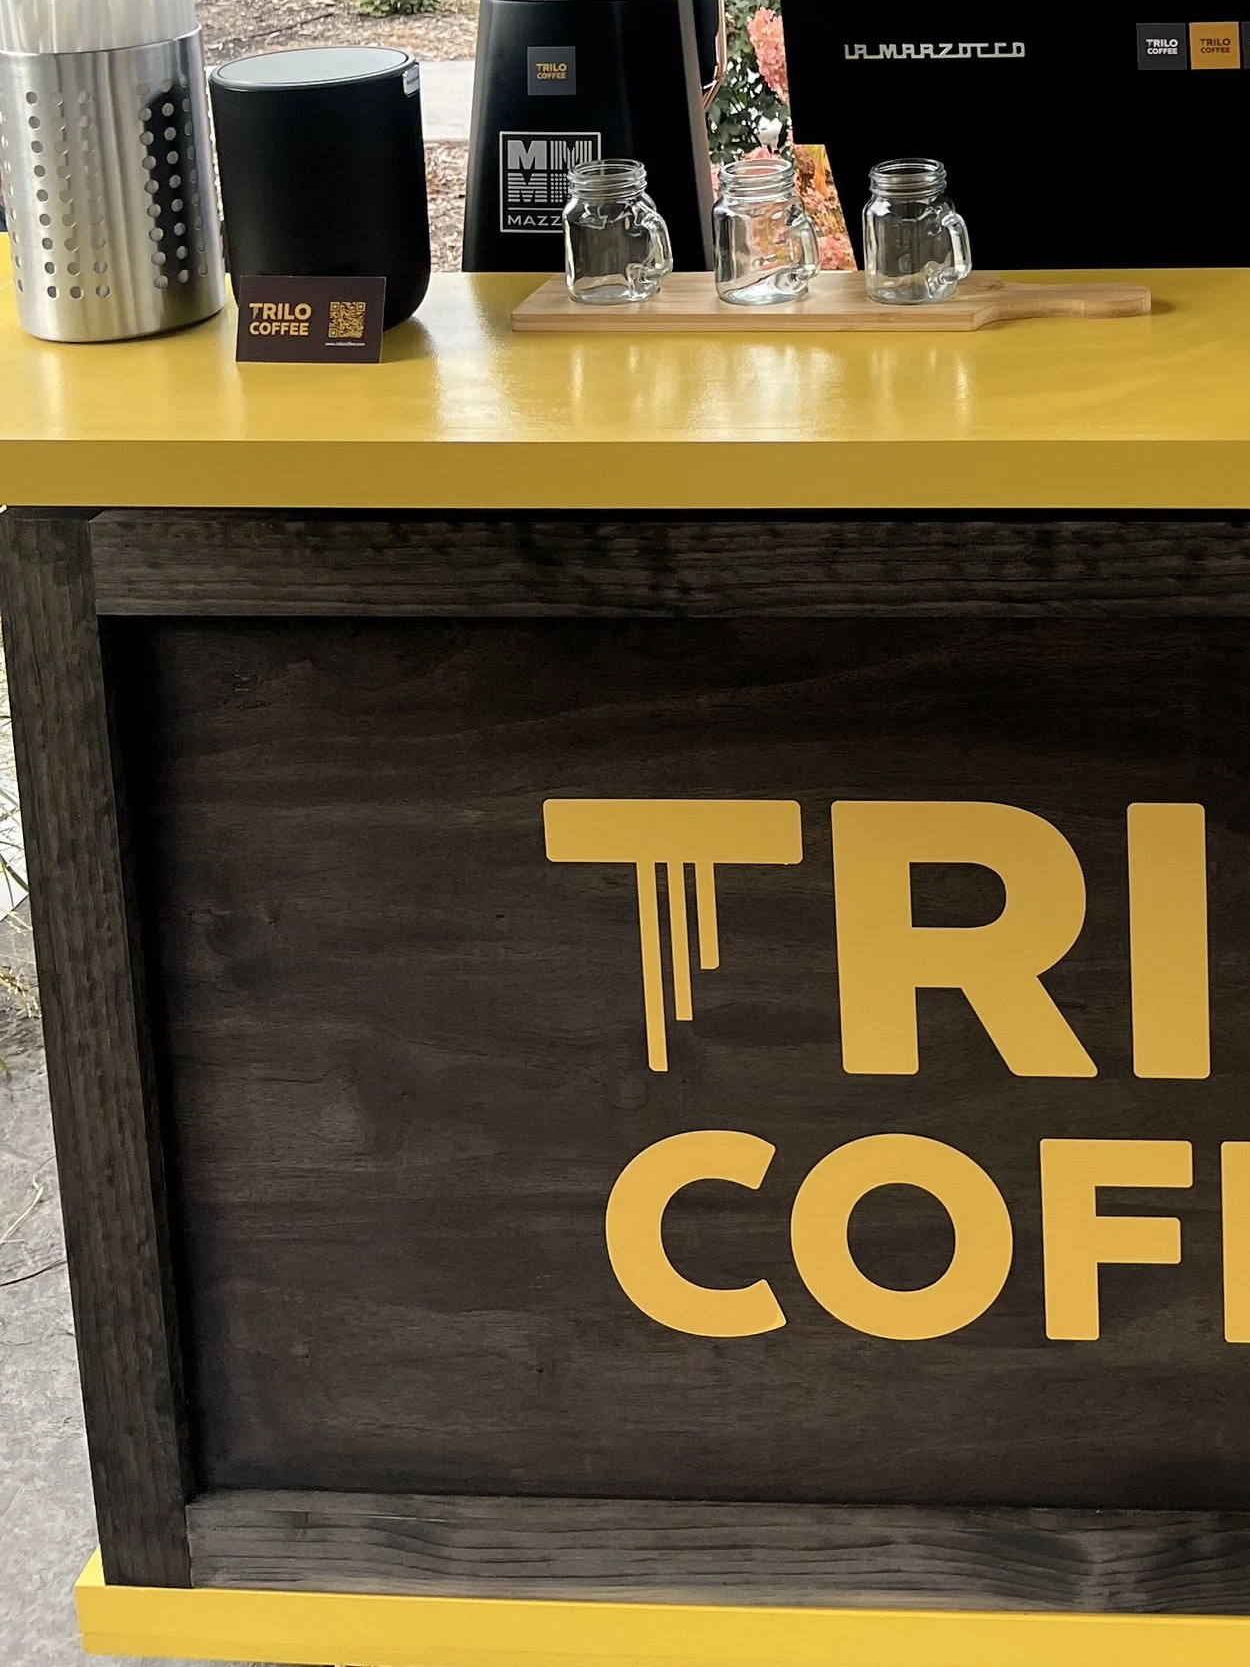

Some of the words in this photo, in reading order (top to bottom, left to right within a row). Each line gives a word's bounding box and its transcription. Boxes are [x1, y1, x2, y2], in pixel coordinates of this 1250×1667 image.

[1145, 39, 1179, 48] TRILO
[1199, 38, 1231, 47] TRILO
[1147, 47, 1179, 55] COFFEE
[1200, 46, 1231, 54] COFFEE
[535, 63, 567, 72] TRILO
[536, 72, 567, 80] COFFEE
[508, 215, 564, 226] MAZZ
[249, 302, 312, 320] TRILO
[249, 321, 309, 336] COFFEE
